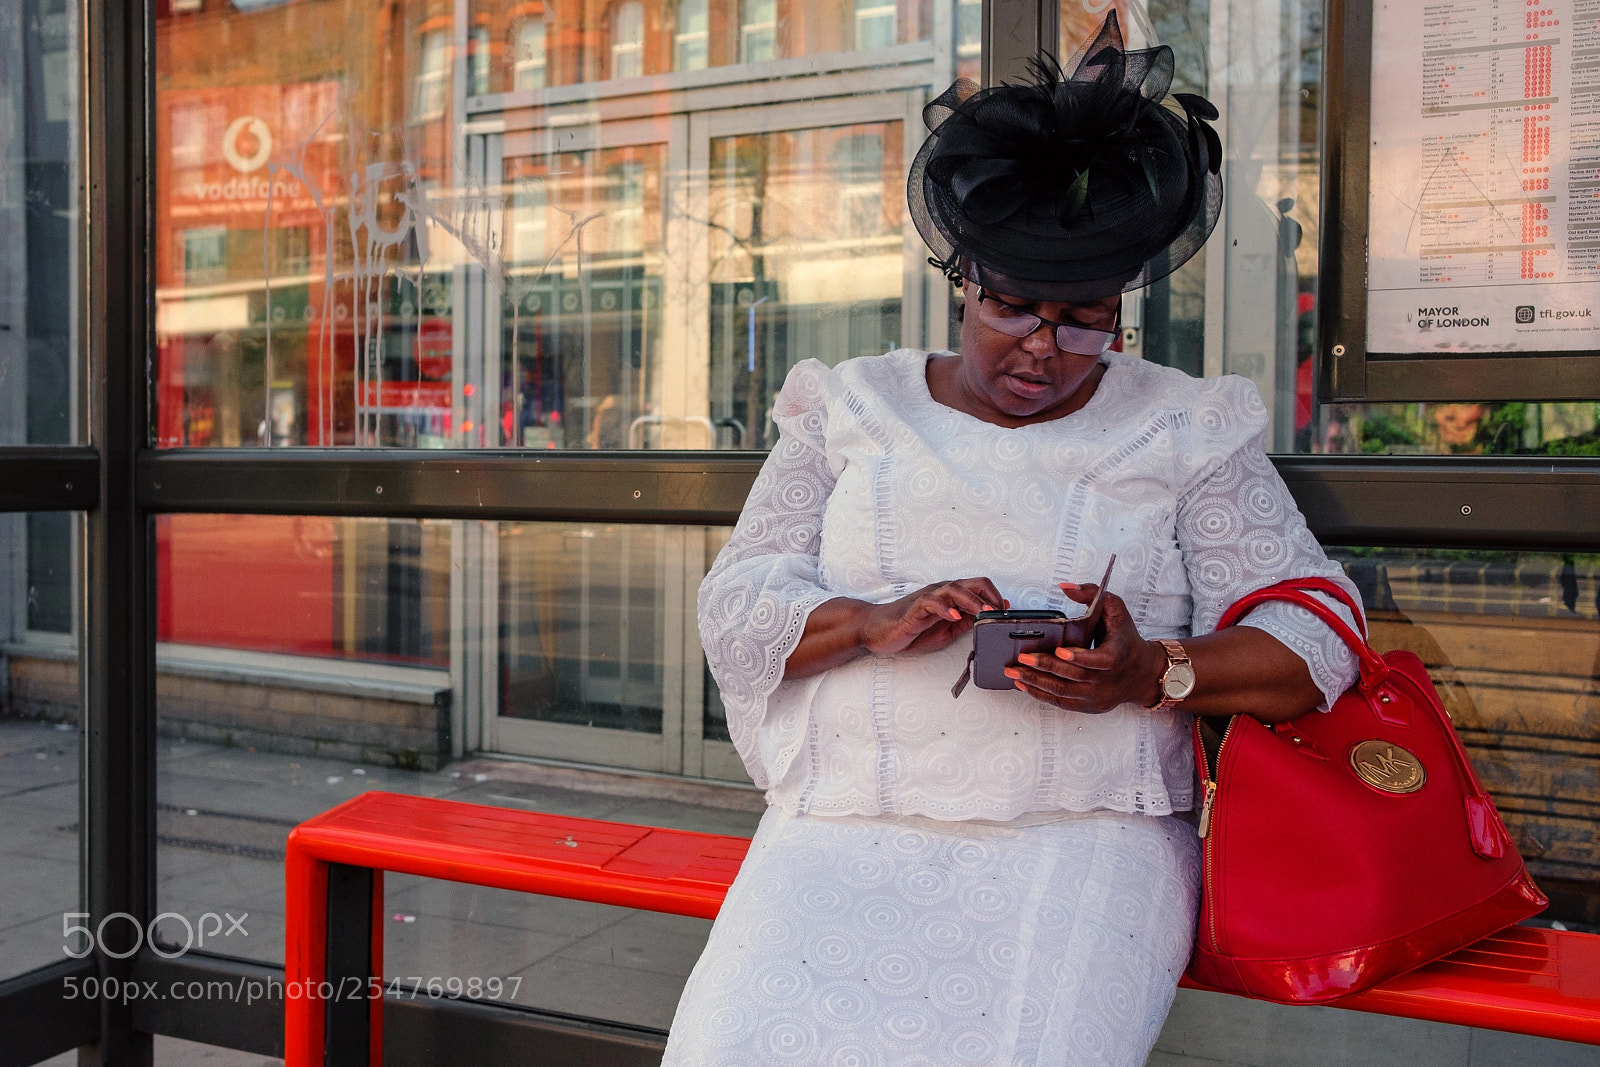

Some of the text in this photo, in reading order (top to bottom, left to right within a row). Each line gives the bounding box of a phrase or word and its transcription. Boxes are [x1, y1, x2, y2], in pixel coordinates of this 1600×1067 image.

[194, 176, 301, 200] vodafone
[1418, 307, 1459, 317] MAYOR
[1540, 308, 1592, 319] tfl.gov.uk
[1418, 318, 1490, 328] OF LONDON
[1359, 747, 1412, 781] MK
